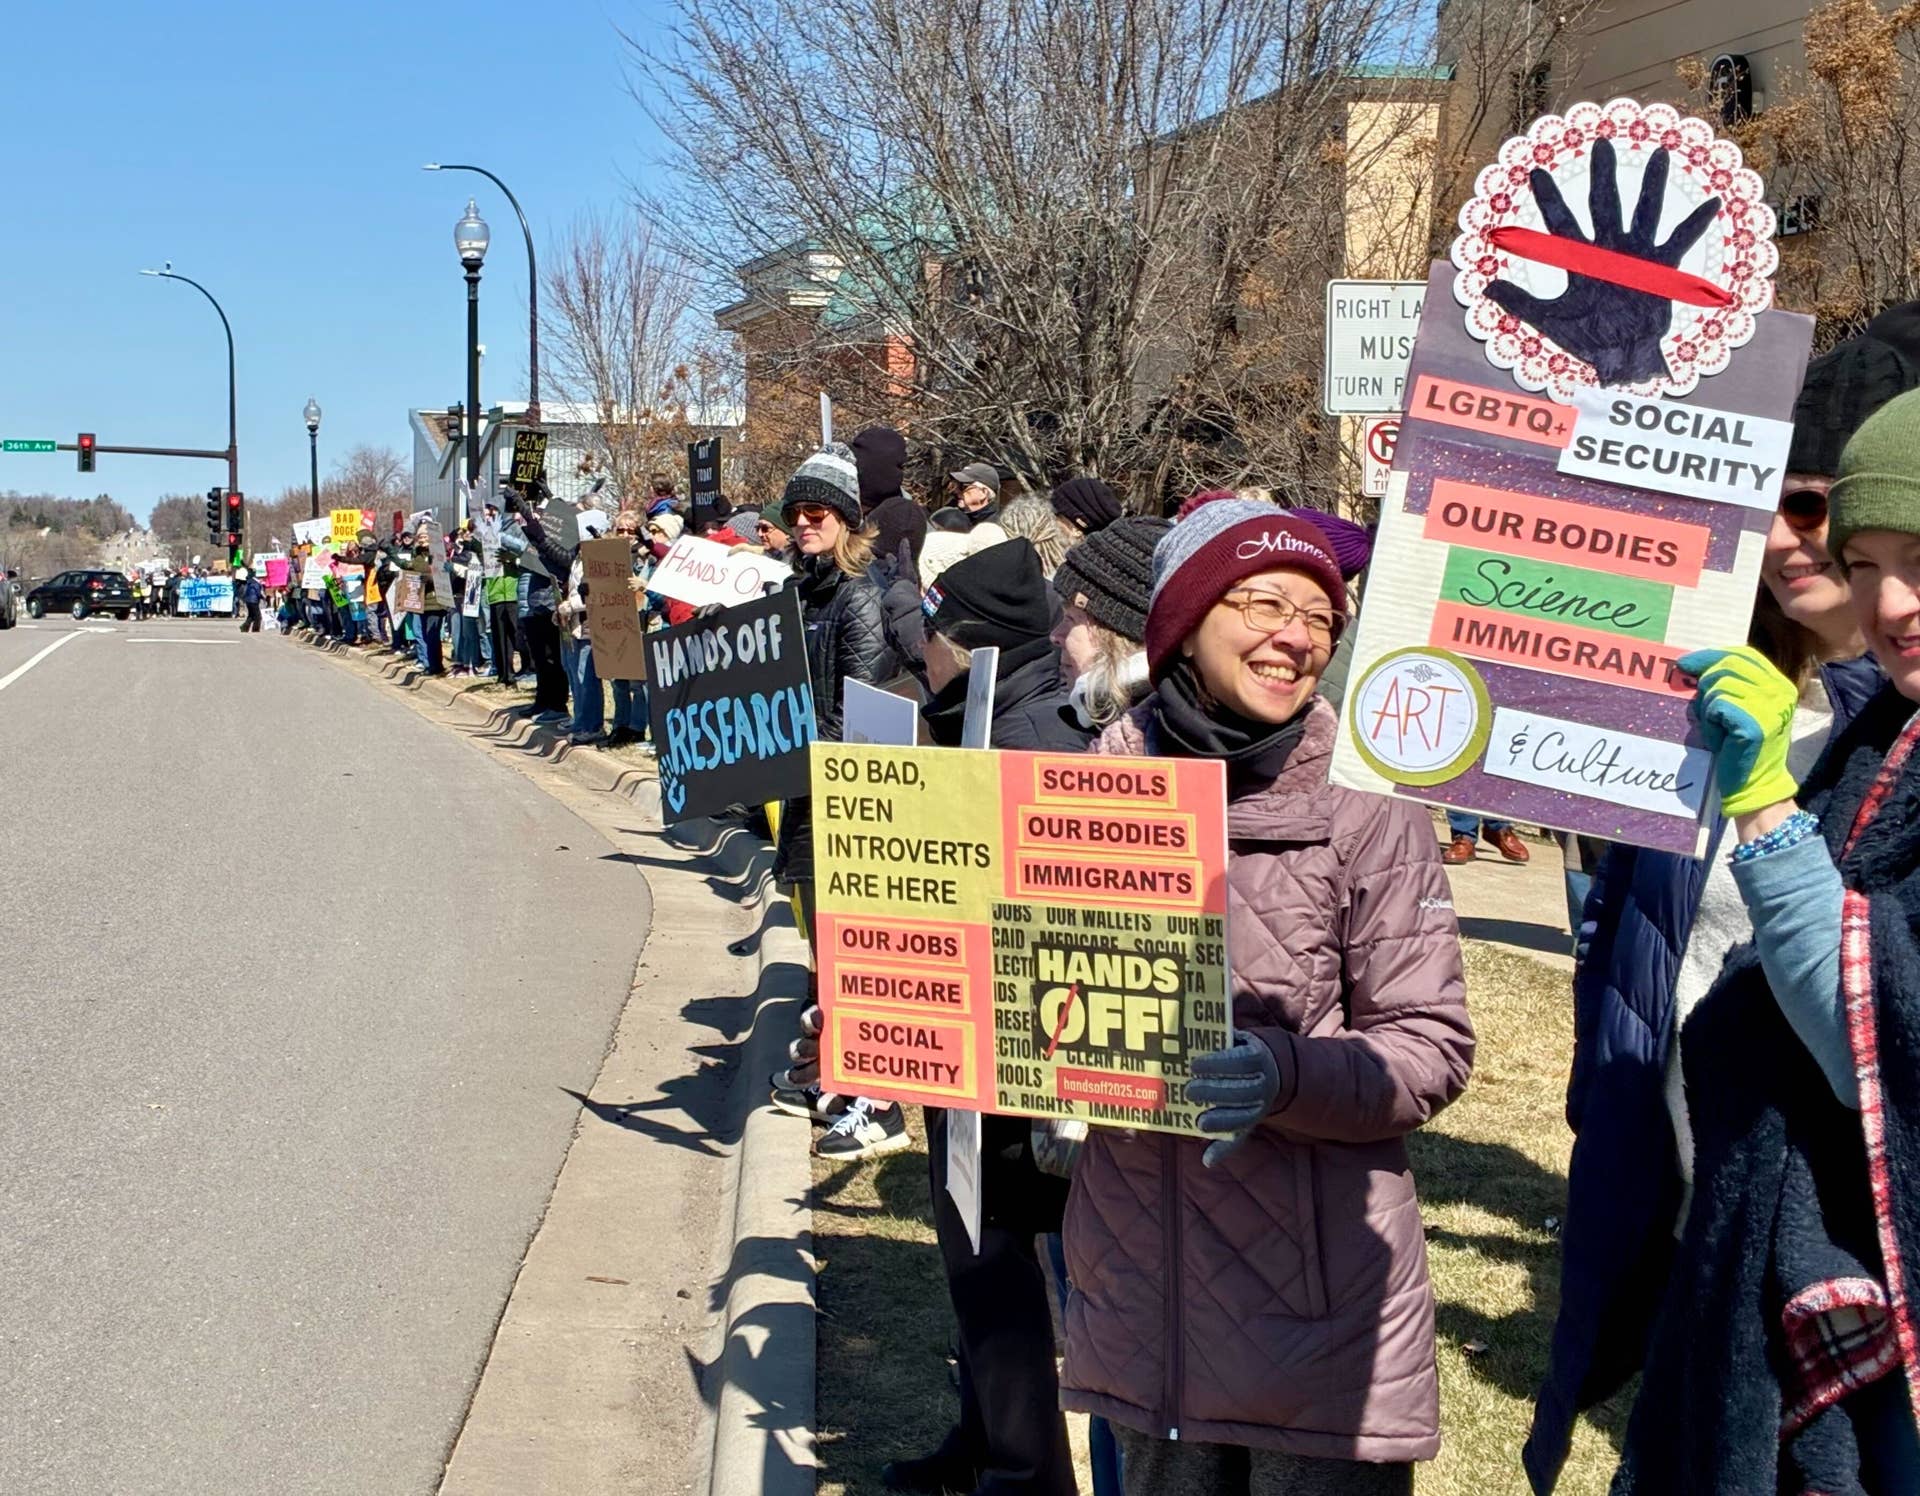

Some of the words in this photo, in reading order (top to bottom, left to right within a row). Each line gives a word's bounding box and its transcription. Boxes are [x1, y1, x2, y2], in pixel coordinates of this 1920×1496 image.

[1336, 299, 1391, 319] RIGHT
[1360, 336, 1418, 360] MUS
[1334, 377, 1383, 396] TURN
[1425, 384, 1568, 436] LGBTQ+
[1608, 400, 1754, 447] SOCIAL
[7, 442, 30, 450] 36th
[34, 442, 53, 450] Ave
[1573, 435, 1776, 492] SECURITY
[1373, 480, 1389, 490] TI
[336, 513, 354, 523] BAD
[1442, 502, 1525, 539] OUR
[1532, 517, 1679, 567] BODIES
[665, 544, 728, 585] HANDS
[1460, 559, 1653, 628] Science
[653, 625, 733, 688] HANDS
[737, 614, 782, 664] OFF
[666, 682, 819, 775] RESEARCH
[1371, 676, 1464, 756] ART
[825, 757, 859, 782] SO
[867, 760, 925, 791] BAD,
[1532, 731, 1694, 793] Culture
[1043, 769, 1167, 797] SCHOOLS
[826, 795, 893, 823] EVEN
[1028, 816, 1082, 840] OUR
[1089, 821, 1186, 848] BODIES
[828, 833, 991, 869] INTROVERTS
[828, 872, 879, 898] ARE
[887, 876, 957, 905] HERE
[1024, 864, 1192, 895] IMMIGRANTS
[1047, 906, 1077, 926] OUR
[1082, 909, 1152, 932] WALLETS
[1167, 915, 1200, 936] OUR
[842, 928, 890, 951] OUR
[896, 933, 958, 957] JOBS
[992, 927, 1025, 949] CAID
[1038, 948, 1180, 994] HANDS
[841, 974, 961, 1004] MEDICARE
[859, 1021, 943, 1051] SOCIAL
[1040, 987, 1180, 1055] OFF!
[843, 1050, 960, 1084] SECURITY
[1064, 1076, 1158, 1101] handsoff2025.com
[1020, 1093, 1074, 1114] RIGHTS
[1089, 1101, 1193, 1129] IMMIGRANTS
